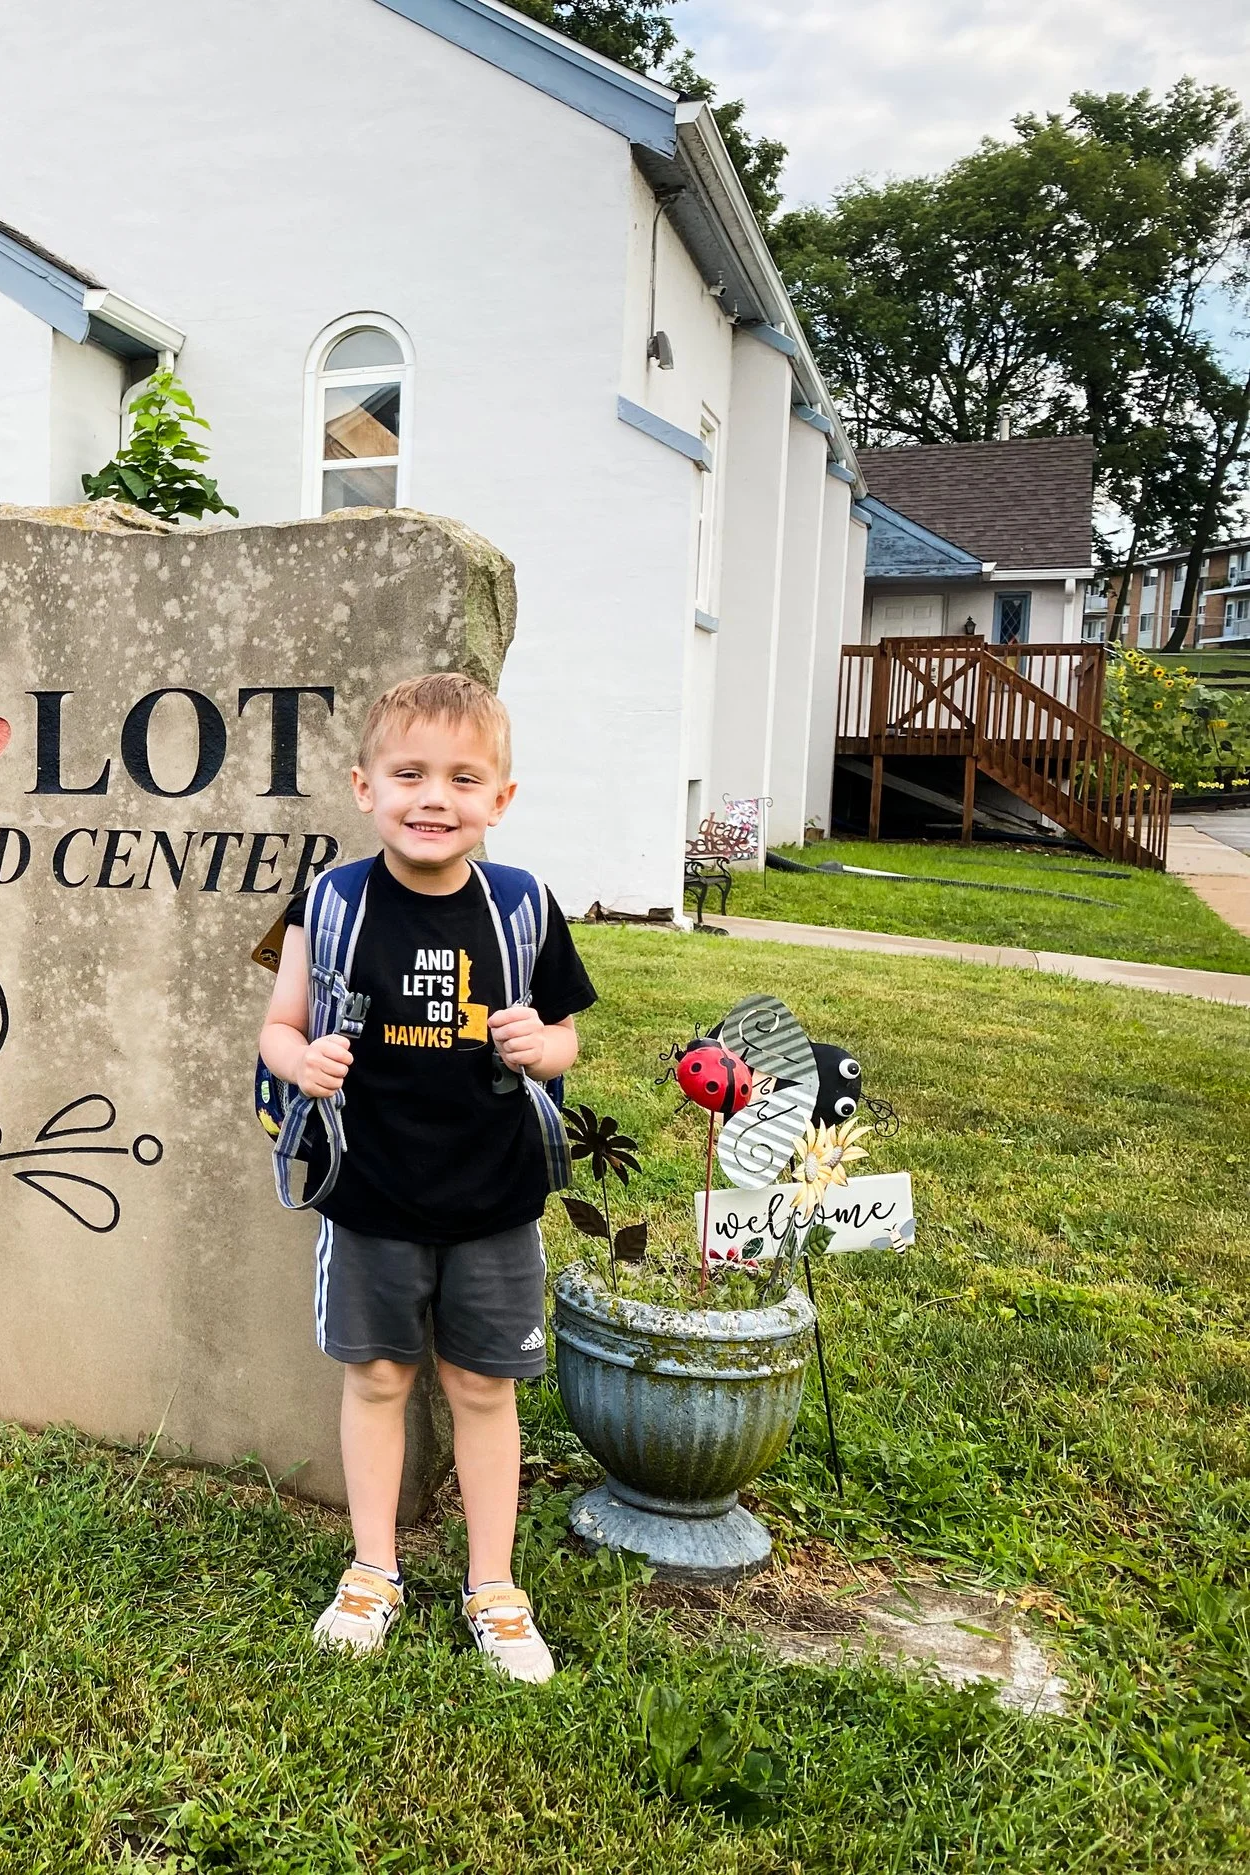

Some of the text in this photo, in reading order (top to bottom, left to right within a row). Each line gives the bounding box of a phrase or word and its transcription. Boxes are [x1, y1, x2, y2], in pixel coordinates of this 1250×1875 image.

[24, 686, 335, 798] LOT
[52, 827, 338, 894] CENTER
[414, 949, 455, 971] AND
[402, 974, 455, 997] LET'S
[427, 1000, 453, 1022] GO
[383, 1024, 453, 1049] HAWKS
